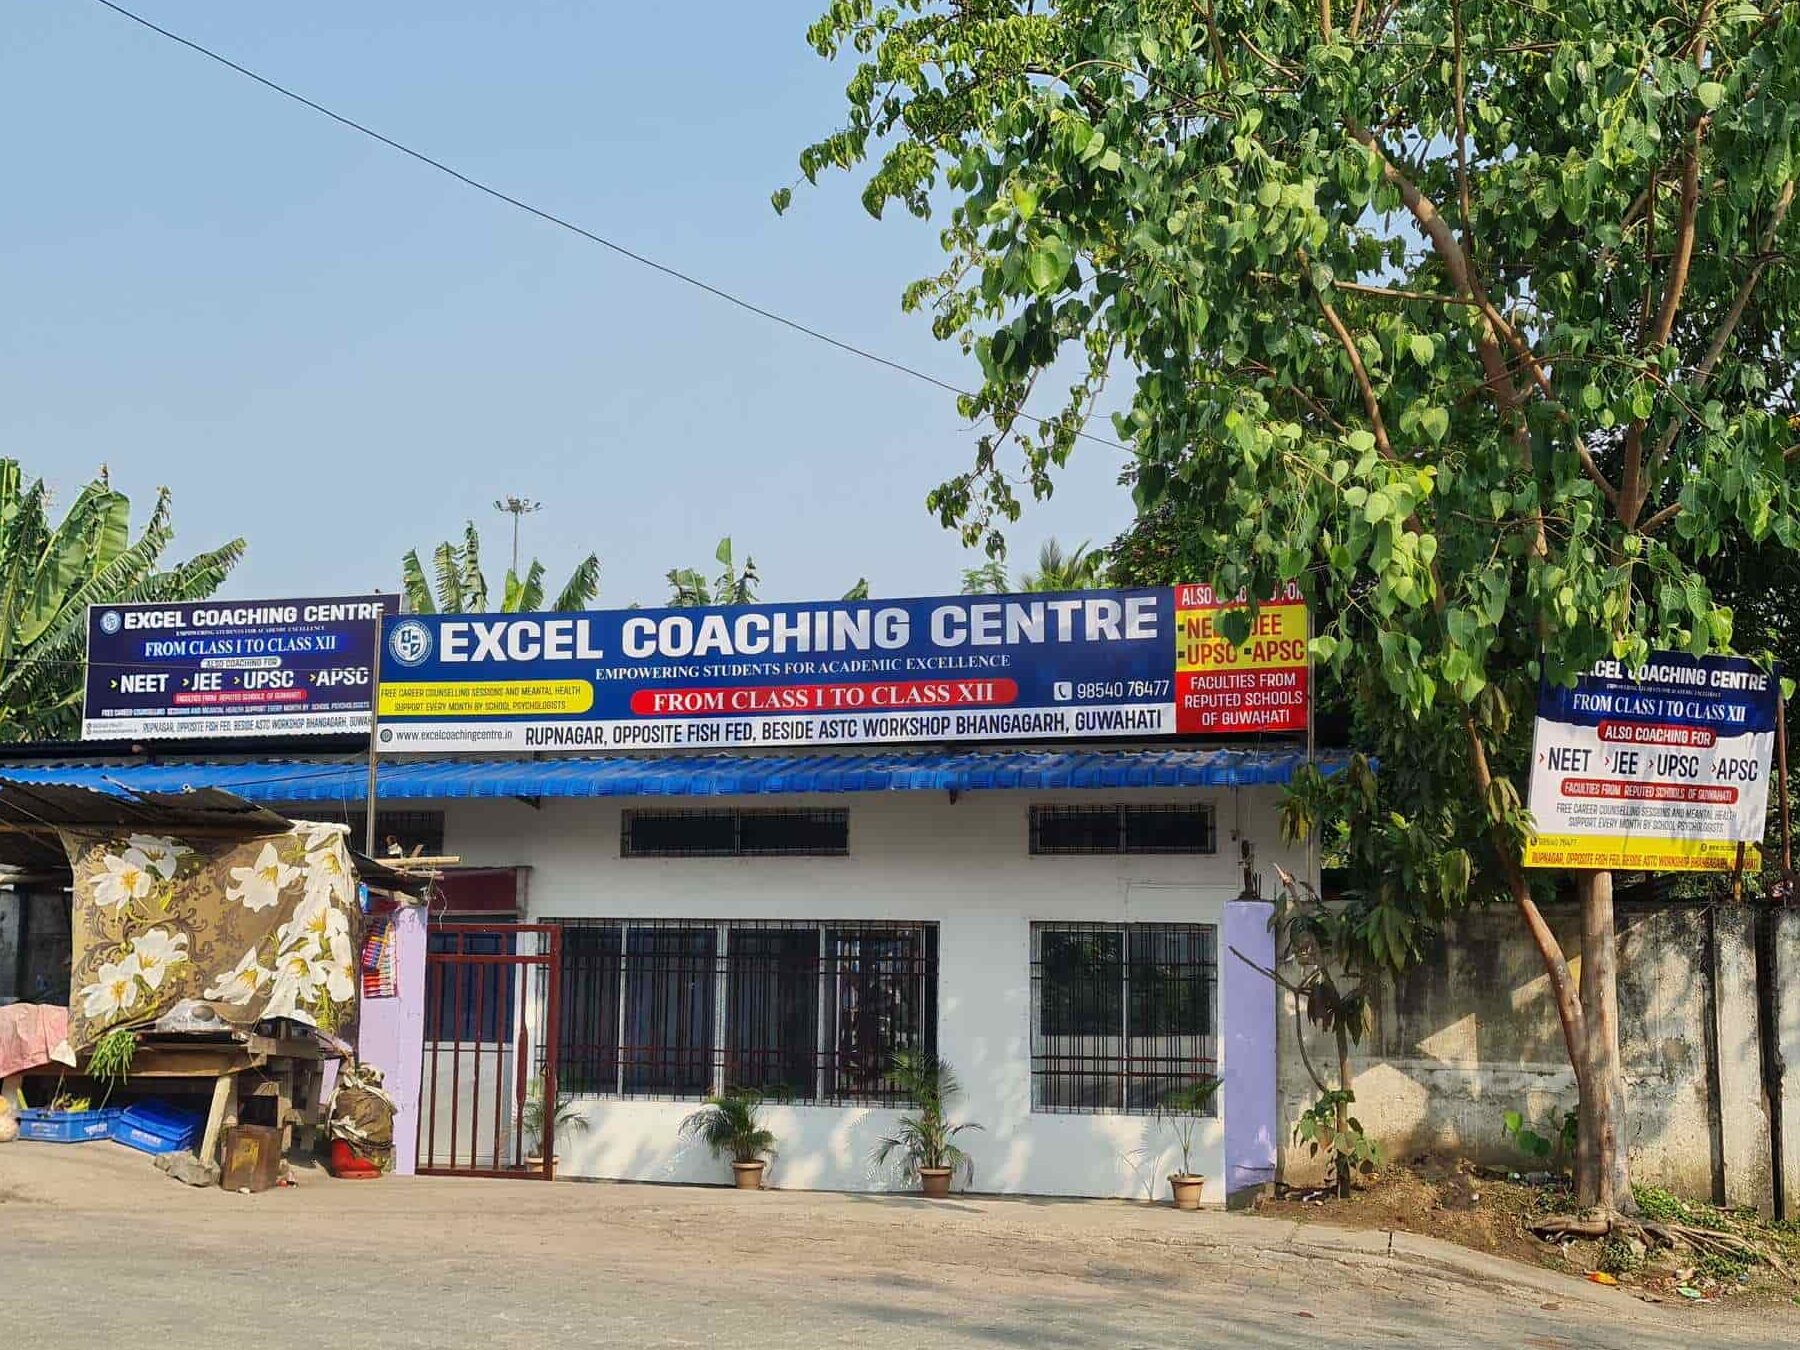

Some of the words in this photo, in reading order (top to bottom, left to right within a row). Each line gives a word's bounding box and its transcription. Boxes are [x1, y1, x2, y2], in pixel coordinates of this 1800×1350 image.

[1182, 587, 1212, 606] ALSO
[124, 611, 187, 630] EXCEL
[192, 607, 297, 627] COACHING
[440, 619, 603, 662] EXCEL
[622, 608, 910, 658] COACHING
[931, 596, 1157, 647] CENTRE
[1251, 613, 1282, 636] JEE
[144, 641, 187, 657] FROM
[189, 639, 233, 655] CLASS
[236, 639, 241, 654] I
[245, 638, 264, 653] TO
[267, 637, 311, 652] CLASS
[315, 636, 336, 650] XII
[1187, 643, 1238, 666] UPSC
[1251, 639, 1305, 662] APSC
[596, 665, 699, 680] EMPOWERING
[702, 662, 780, 677] STUDENTS
[784, 661, 815, 674] FOR
[818, 658, 901, 674] ACADEMIC
[906, 654, 1011, 670] EXCELLENCE
[120, 673, 169, 693] NEET
[191, 672, 223, 691] JEE
[243, 670, 294, 689] UPSC
[315, 667, 369, 687] APSC
[1077, 681, 1123, 699] 98540
[1127, 680, 1170, 698] 76477
[1190, 674, 1255, 690] FACULTIES
[1259, 672, 1296, 687] FROM
[1711, 670, 1768, 691] CENTRE
[381, 688, 397, 697] FREE
[505, 687, 520, 696] AND
[521, 686, 552, 695] MEANTAL
[555, 685, 581, 695] HEALTH
[653, 691, 725, 712] FROM
[731, 689, 809, 709] CLASS
[816, 687, 823, 706] I
[830, 685, 865, 706] TO
[871, 683, 950, 705] CLASS
[958, 683, 993, 702] XII
[1184, 693, 1241, 708] REPUTED
[1245, 691, 1303, 706] SCHOOLS
[394, 702, 422, 711] SUPPORT
[426, 702, 447, 711] EVERY
[448, 701, 473, 710] MONTH
[474, 701, 483, 710] BY
[485, 701, 510, 710] SCHOOL
[513, 700, 566, 710] PSYCHOLOGISTS
[1573, 693, 1612, 712] FROM
[1615, 696, 1656, 715] CLASS
[1658, 700, 1663, 716] I
[1667, 700, 1684, 717] TO
[1686, 702, 1725, 720] CLASS
[1727, 705, 1747, 722] XII
[525, 726, 608, 746] RUPNAGAR,
[613, 724, 682, 744] OPPOSITE
[687, 723, 720, 742] FISH
[725, 722, 757, 742] FED,
[762, 720, 813, 740] BESIDE
[818, 718, 857, 739] ASTC
[862, 716, 950, 737] WORKSHOP
[956, 712, 1069, 735] BHANGAGARH,
[1075, 709, 1161, 730] GUWAHATI
[1202, 712, 1218, 726] OF
[1222, 709, 1290, 726] GUWAHATI
[1604, 725, 1633, 740] ALSO
[1635, 727, 1689, 744] COACHING
[1691, 731, 1711, 746] FOR
[1548, 747, 1592, 772] NEET
[1611, 750, 1639, 775] JEE
[1657, 753, 1699, 778] UPSC
[1716, 758, 1758, 782] APSC
[1624, 784, 1654, 798] REPUTED
[1688, 788, 1697, 799] OF
[1556, 802, 1573, 814] FREE
[1598, 817, 1616, 829] EVERY
